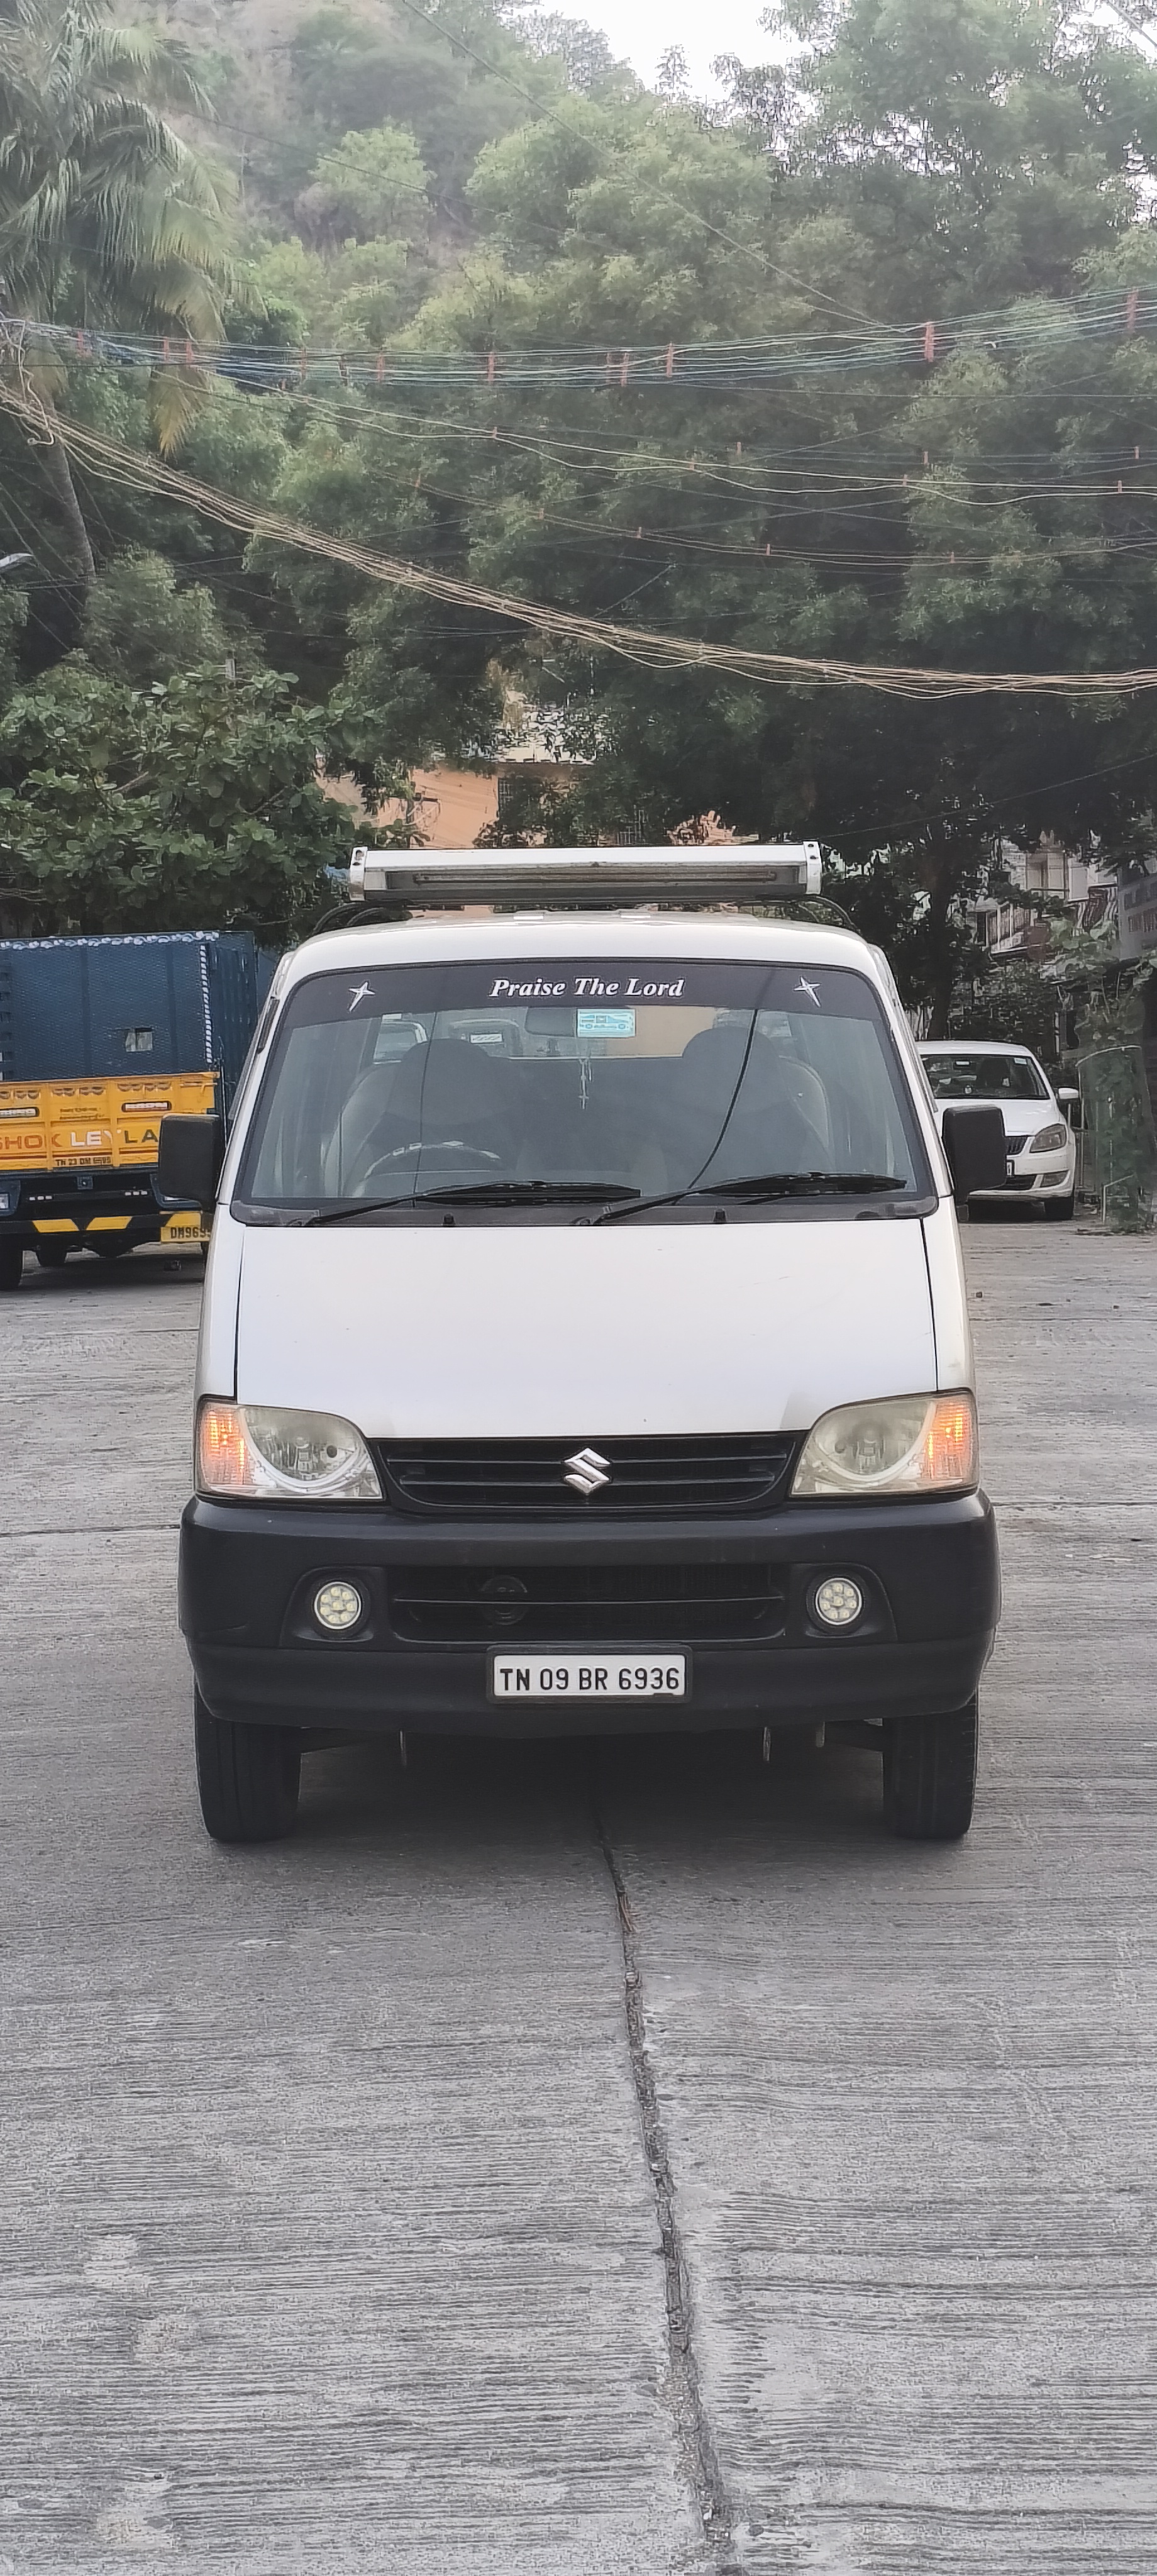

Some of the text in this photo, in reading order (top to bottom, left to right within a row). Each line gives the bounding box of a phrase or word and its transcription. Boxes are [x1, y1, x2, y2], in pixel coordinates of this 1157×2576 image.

[488, 977, 685, 997] Praise The Lord
[0, 1133, 62, 1150] HOK
[499, 1667, 680, 1691] TN 09 BR 6936
